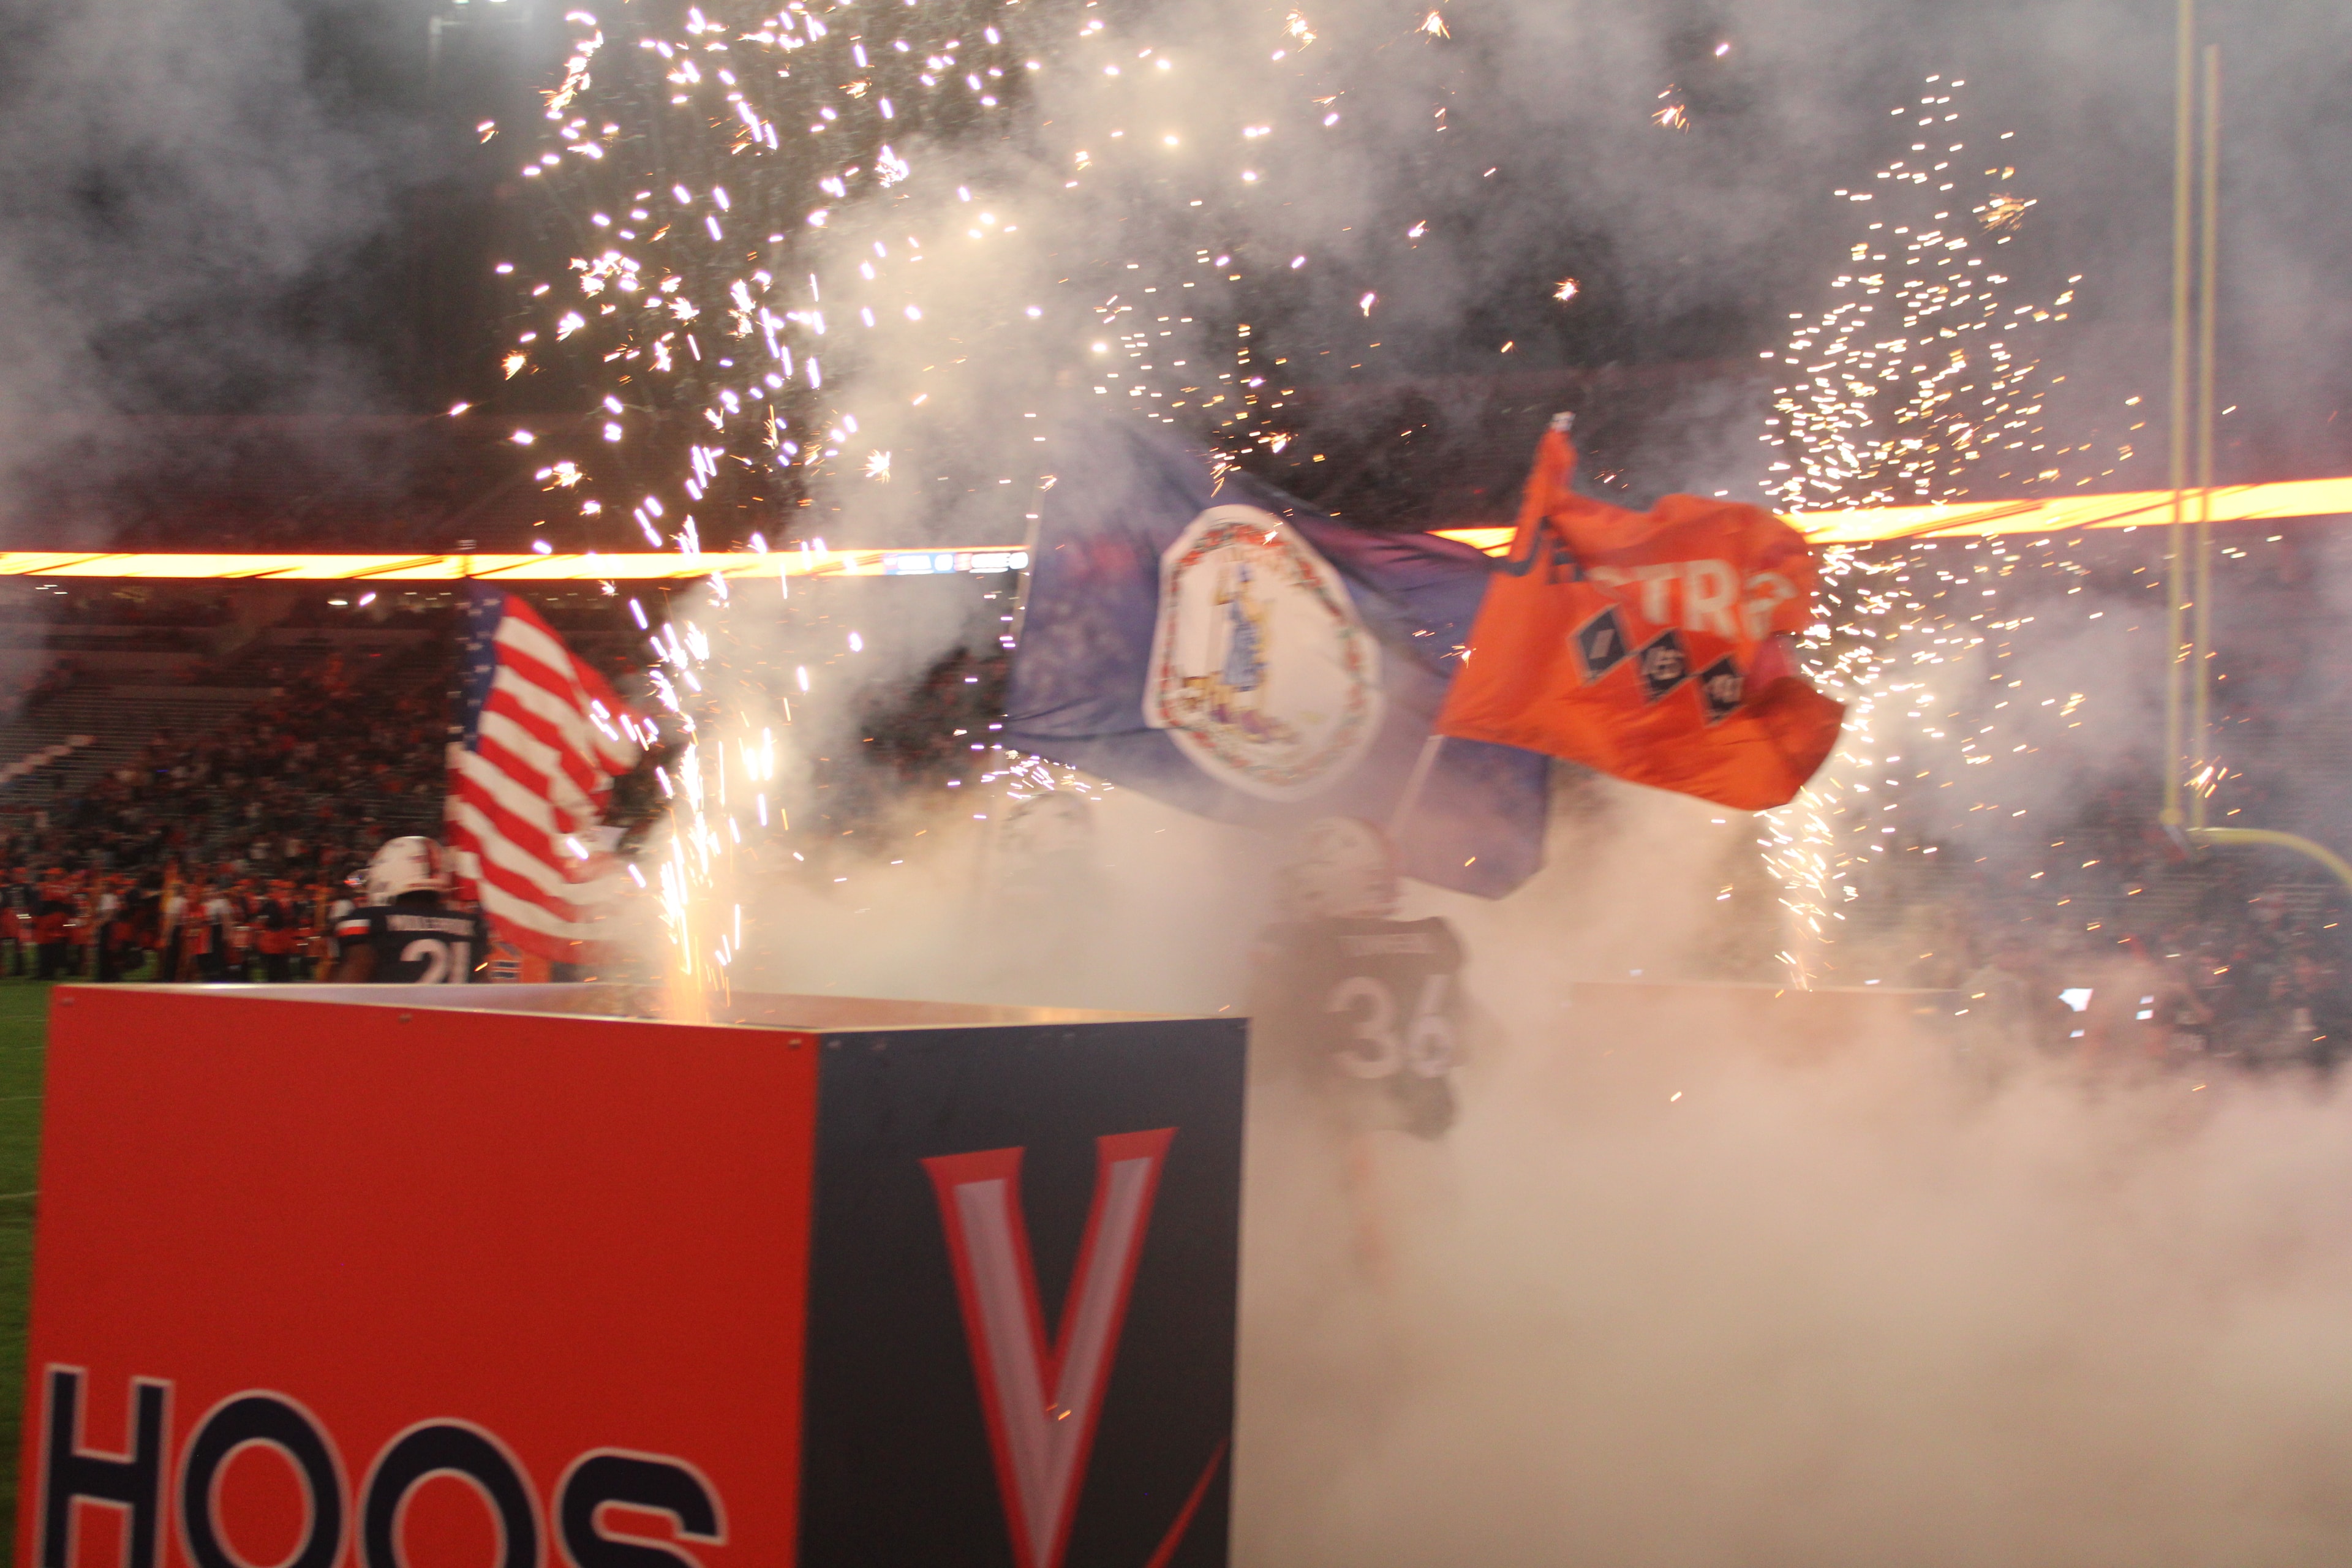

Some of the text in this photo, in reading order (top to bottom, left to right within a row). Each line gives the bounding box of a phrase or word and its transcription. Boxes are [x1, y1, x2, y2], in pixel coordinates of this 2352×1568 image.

[399, 938, 472, 983] 21
[1328, 974, 1454, 1079] 36
[33, 1362, 729, 1568] HOOS
